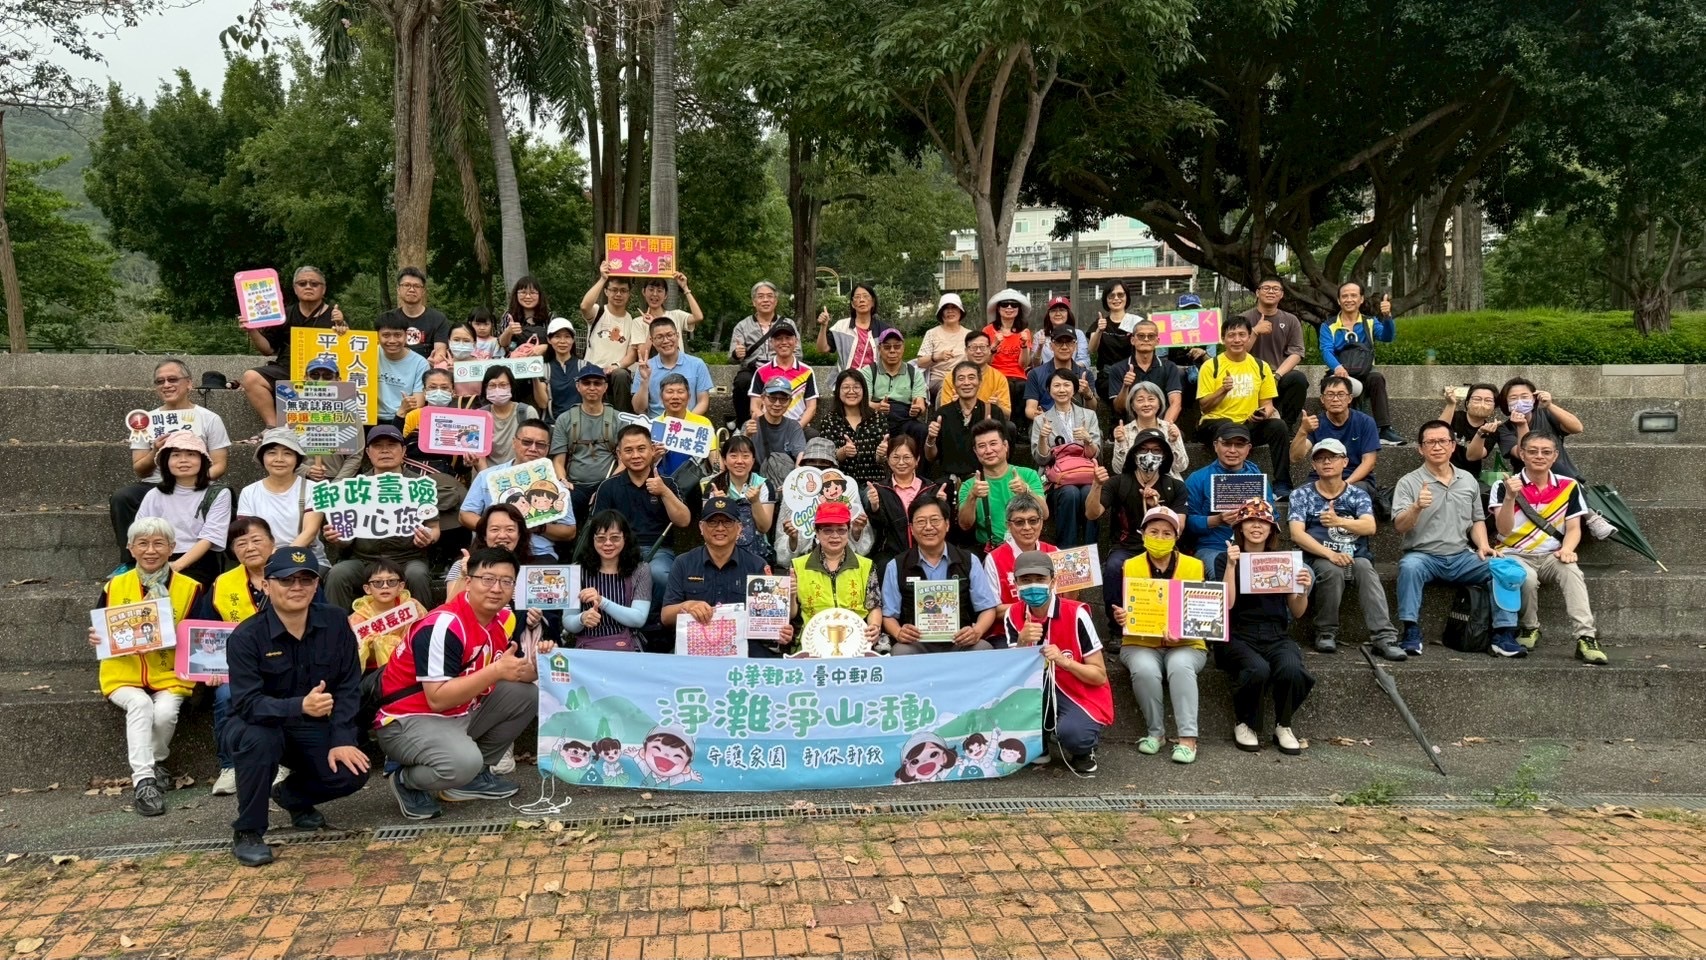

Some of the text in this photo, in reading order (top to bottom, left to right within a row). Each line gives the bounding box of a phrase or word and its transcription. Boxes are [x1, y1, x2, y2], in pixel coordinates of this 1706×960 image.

[608, 237, 673, 253] 喝酒不開車
[287, 401, 344, 412] 無號誌路口
[152, 413, 178, 425] 叫我
[668, 421, 709, 441] 神一般
[665, 433, 706, 454] 的隊友
[313, 474, 436, 510] 郵政壽險
[330, 506, 422, 538] 關心您
[357, 607, 413, 640] 業績長紅
[728, 664, 883, 687] 中華郵政 臺中郵局
[656, 688, 937, 737] 淨灘淨山活動
[708, 745, 883, 769] 守護家園 郵你郵我
